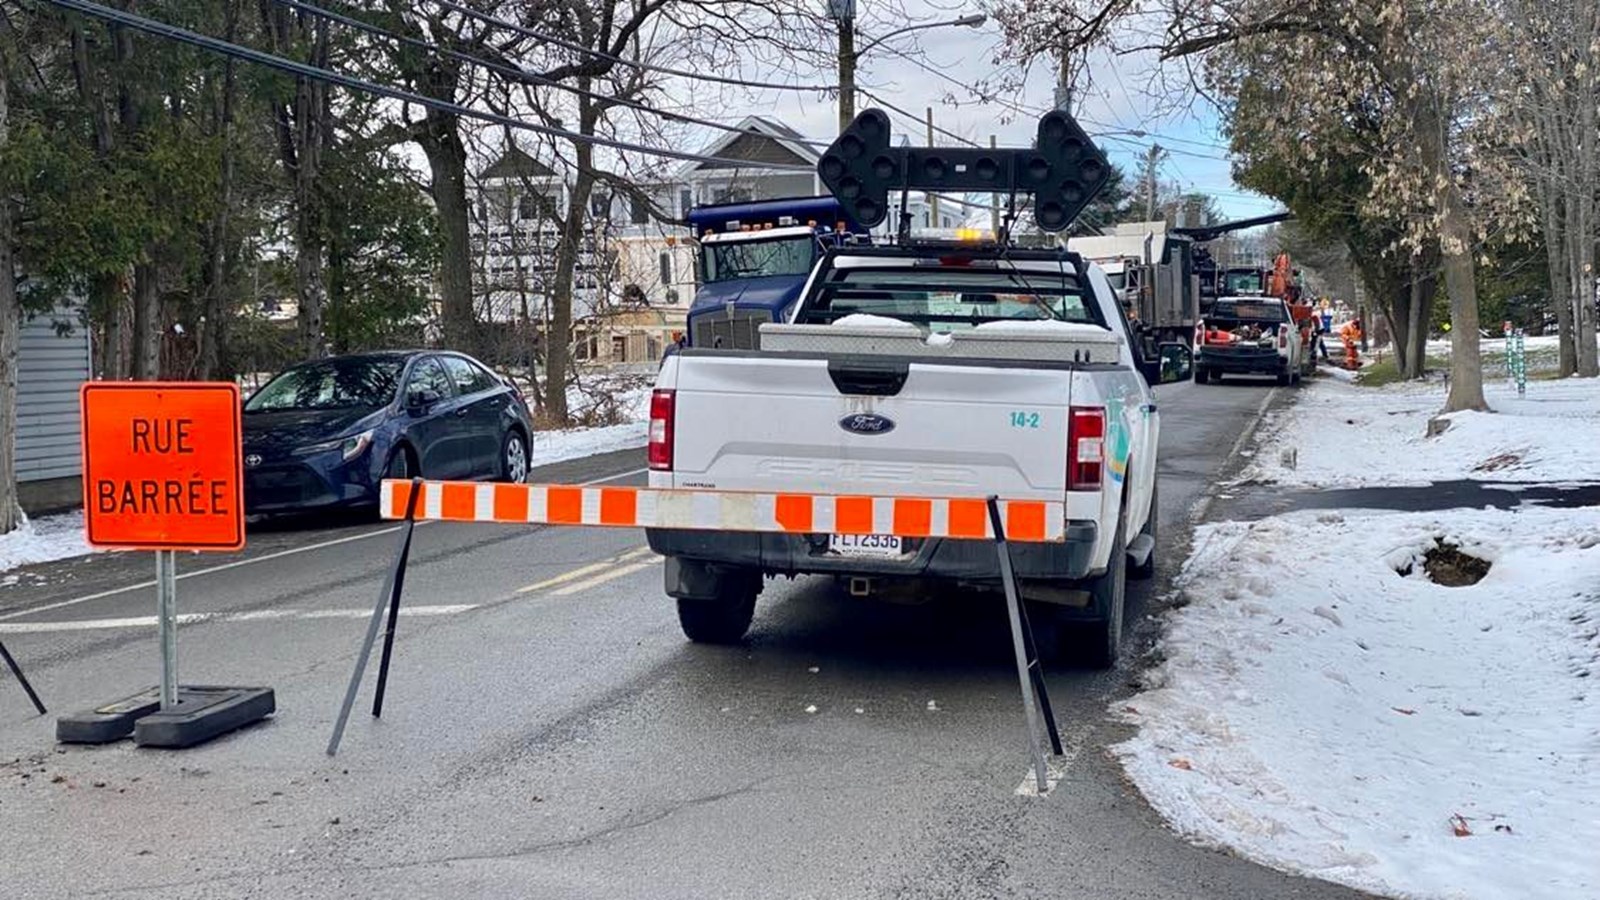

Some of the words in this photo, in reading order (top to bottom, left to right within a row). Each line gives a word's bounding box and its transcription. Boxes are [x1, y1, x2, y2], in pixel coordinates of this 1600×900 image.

[851, 415, 884, 430] Ford
[1010, 411, 1039, 429] 14-2
[132, 418, 194, 453] RUE
[98, 472, 228, 515] BARRÉE
